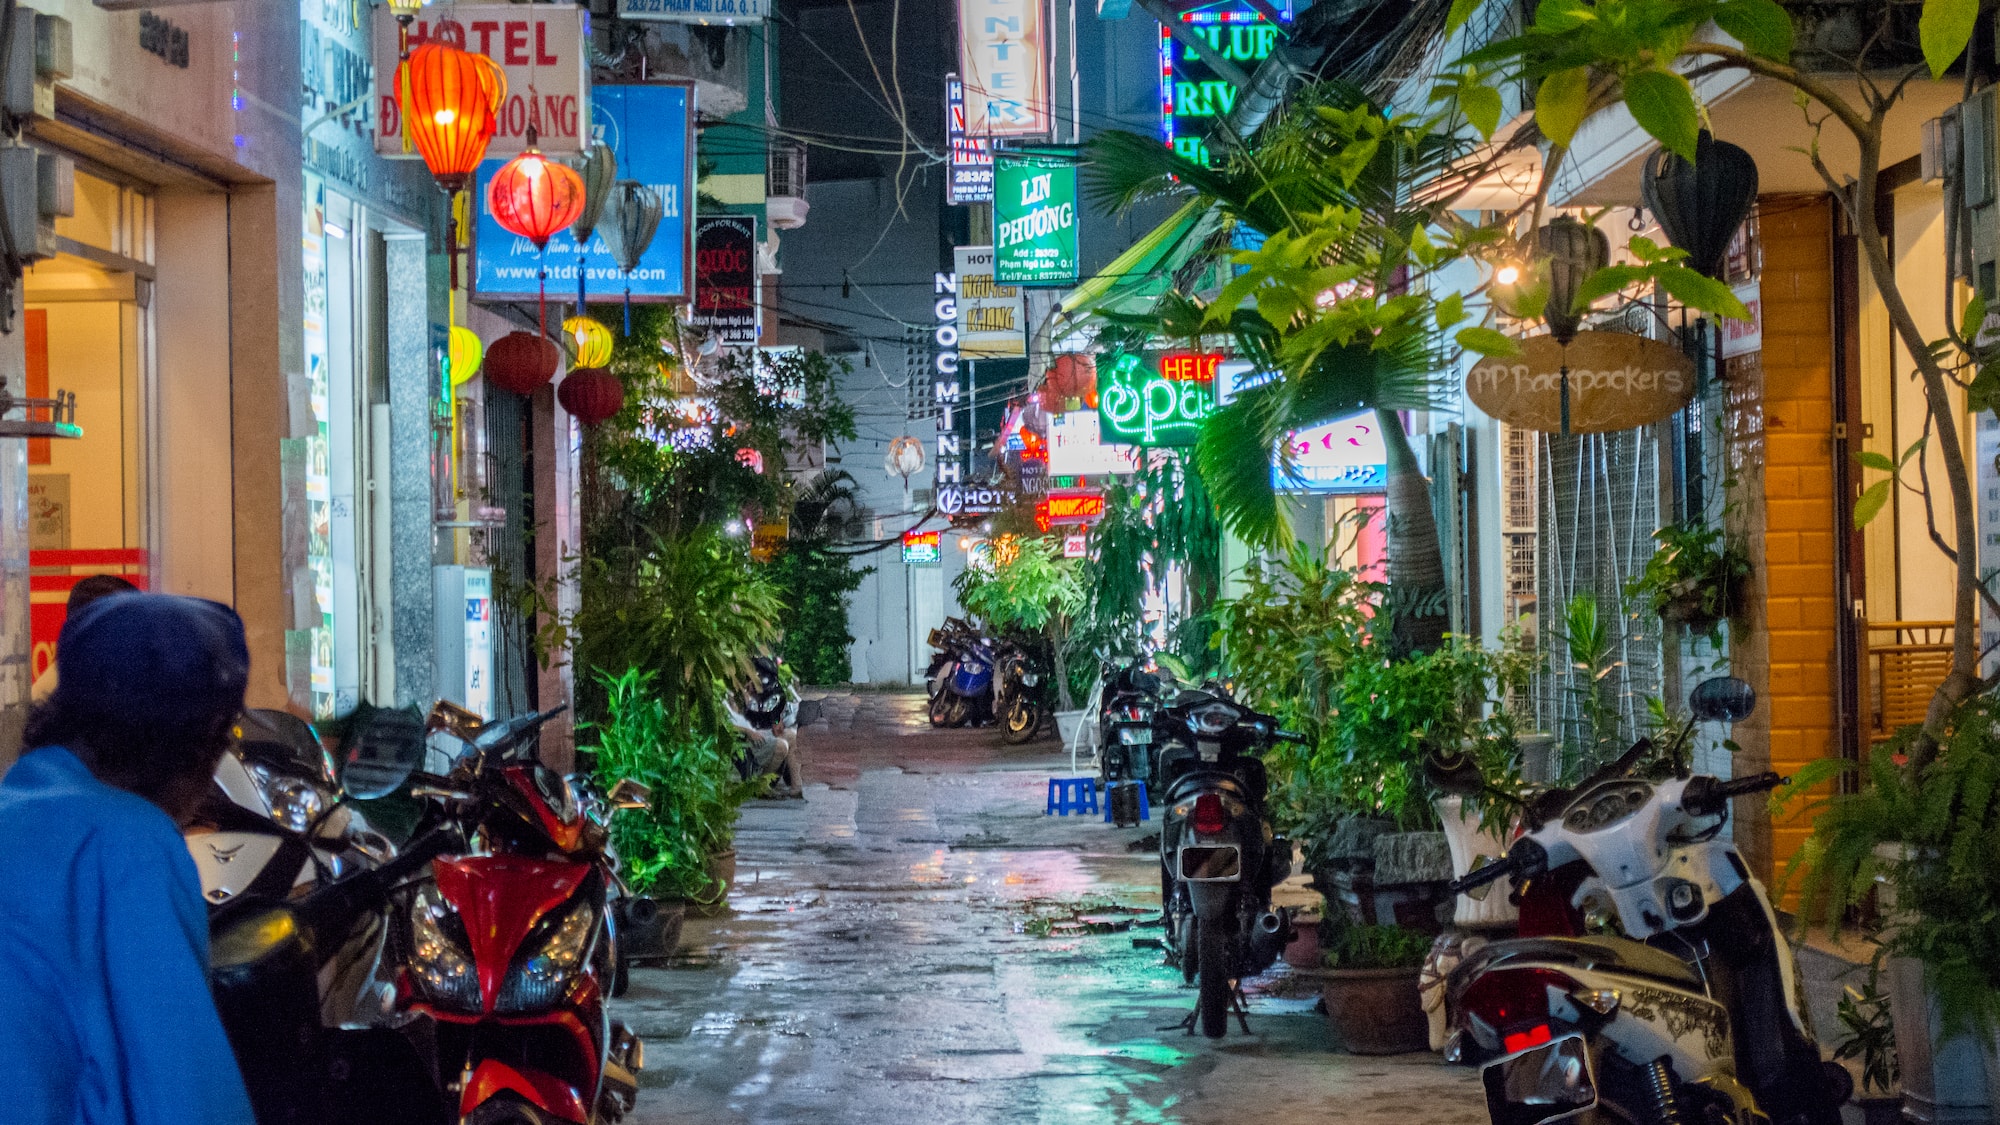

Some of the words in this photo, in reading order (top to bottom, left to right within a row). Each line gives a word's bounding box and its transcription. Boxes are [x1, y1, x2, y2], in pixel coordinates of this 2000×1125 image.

[1175, 81, 1238, 117] RIV
[956, 171, 993, 183] 283/2
[1021, 173, 1052, 206] LIN
[998, 202, 1073, 249] PHƯƠNG
[968, 255, 993, 264] HOT
[1000, 259, 1021, 270] Phạm
[1470, 364, 1509, 394] PP
[1511, 364, 1684, 401] Backpackers
